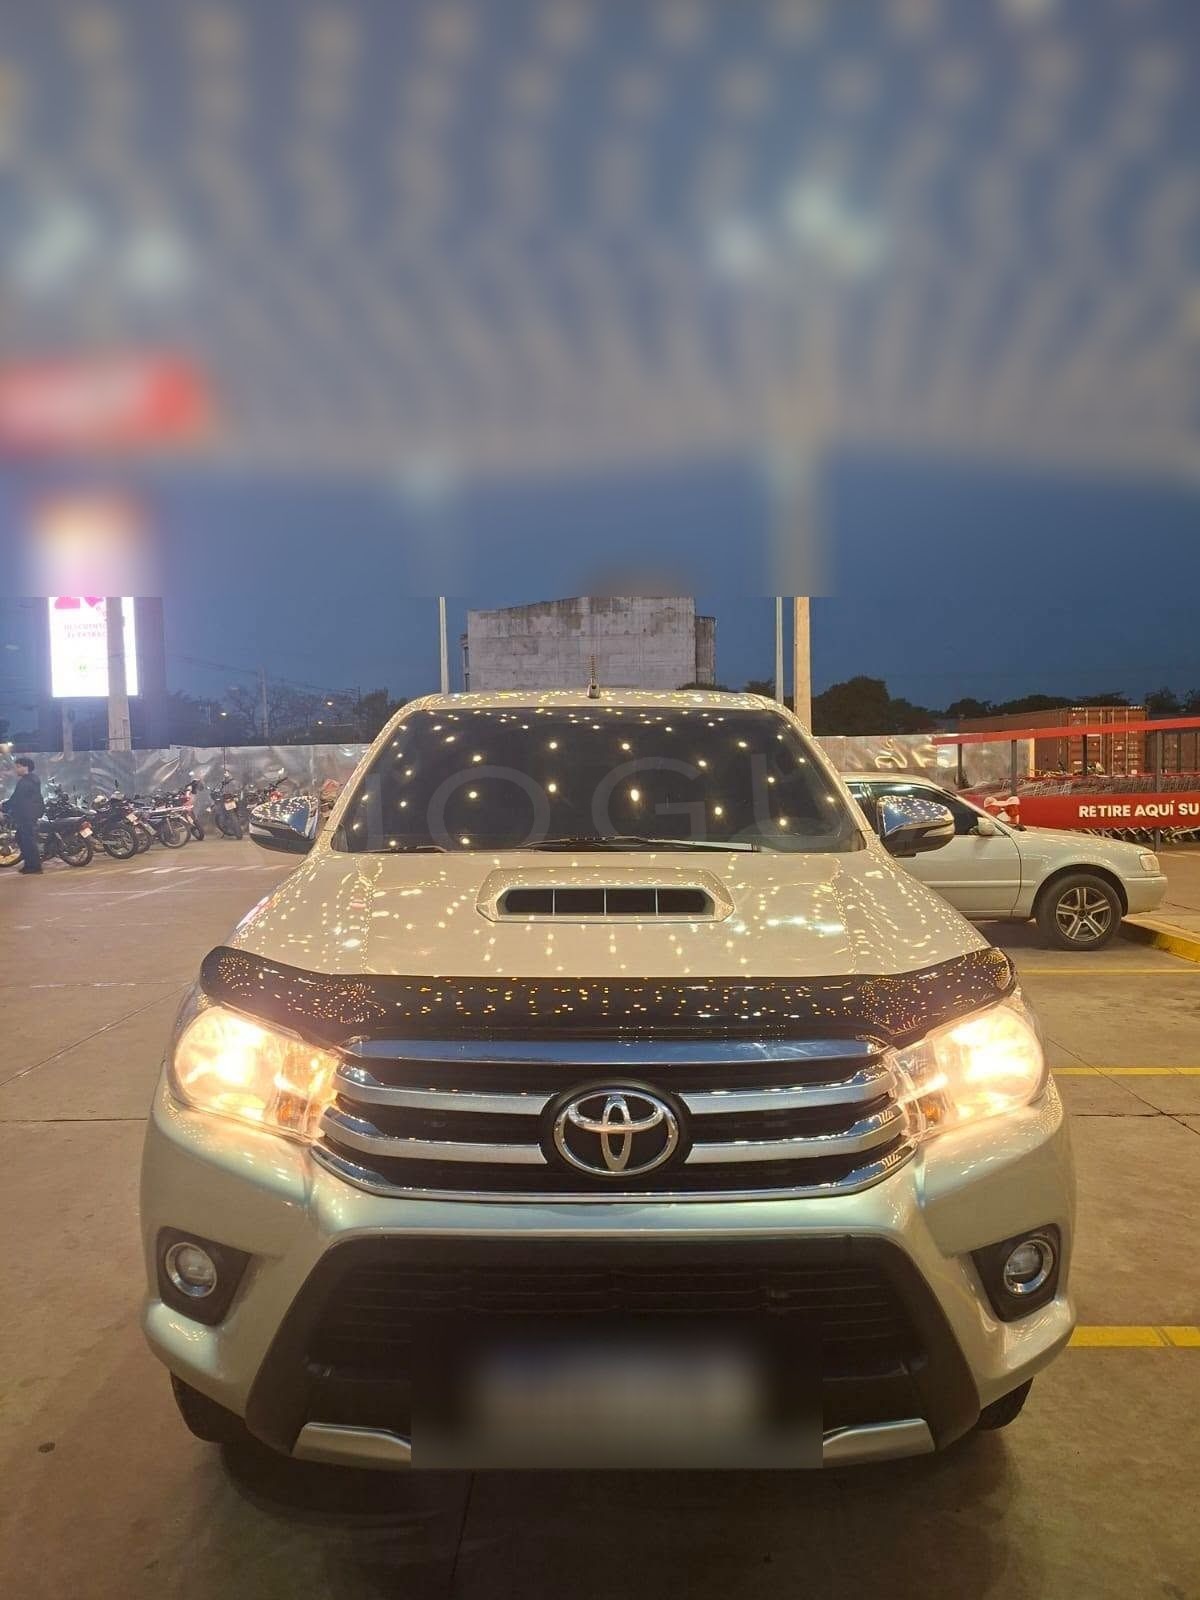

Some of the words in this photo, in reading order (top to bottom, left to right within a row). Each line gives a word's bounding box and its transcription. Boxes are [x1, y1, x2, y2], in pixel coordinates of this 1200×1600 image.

[1078, 805, 1132, 818] RETIRE
[1134, 800, 1175, 818] AQUÍ
[1178, 803, 1200, 815] SU
